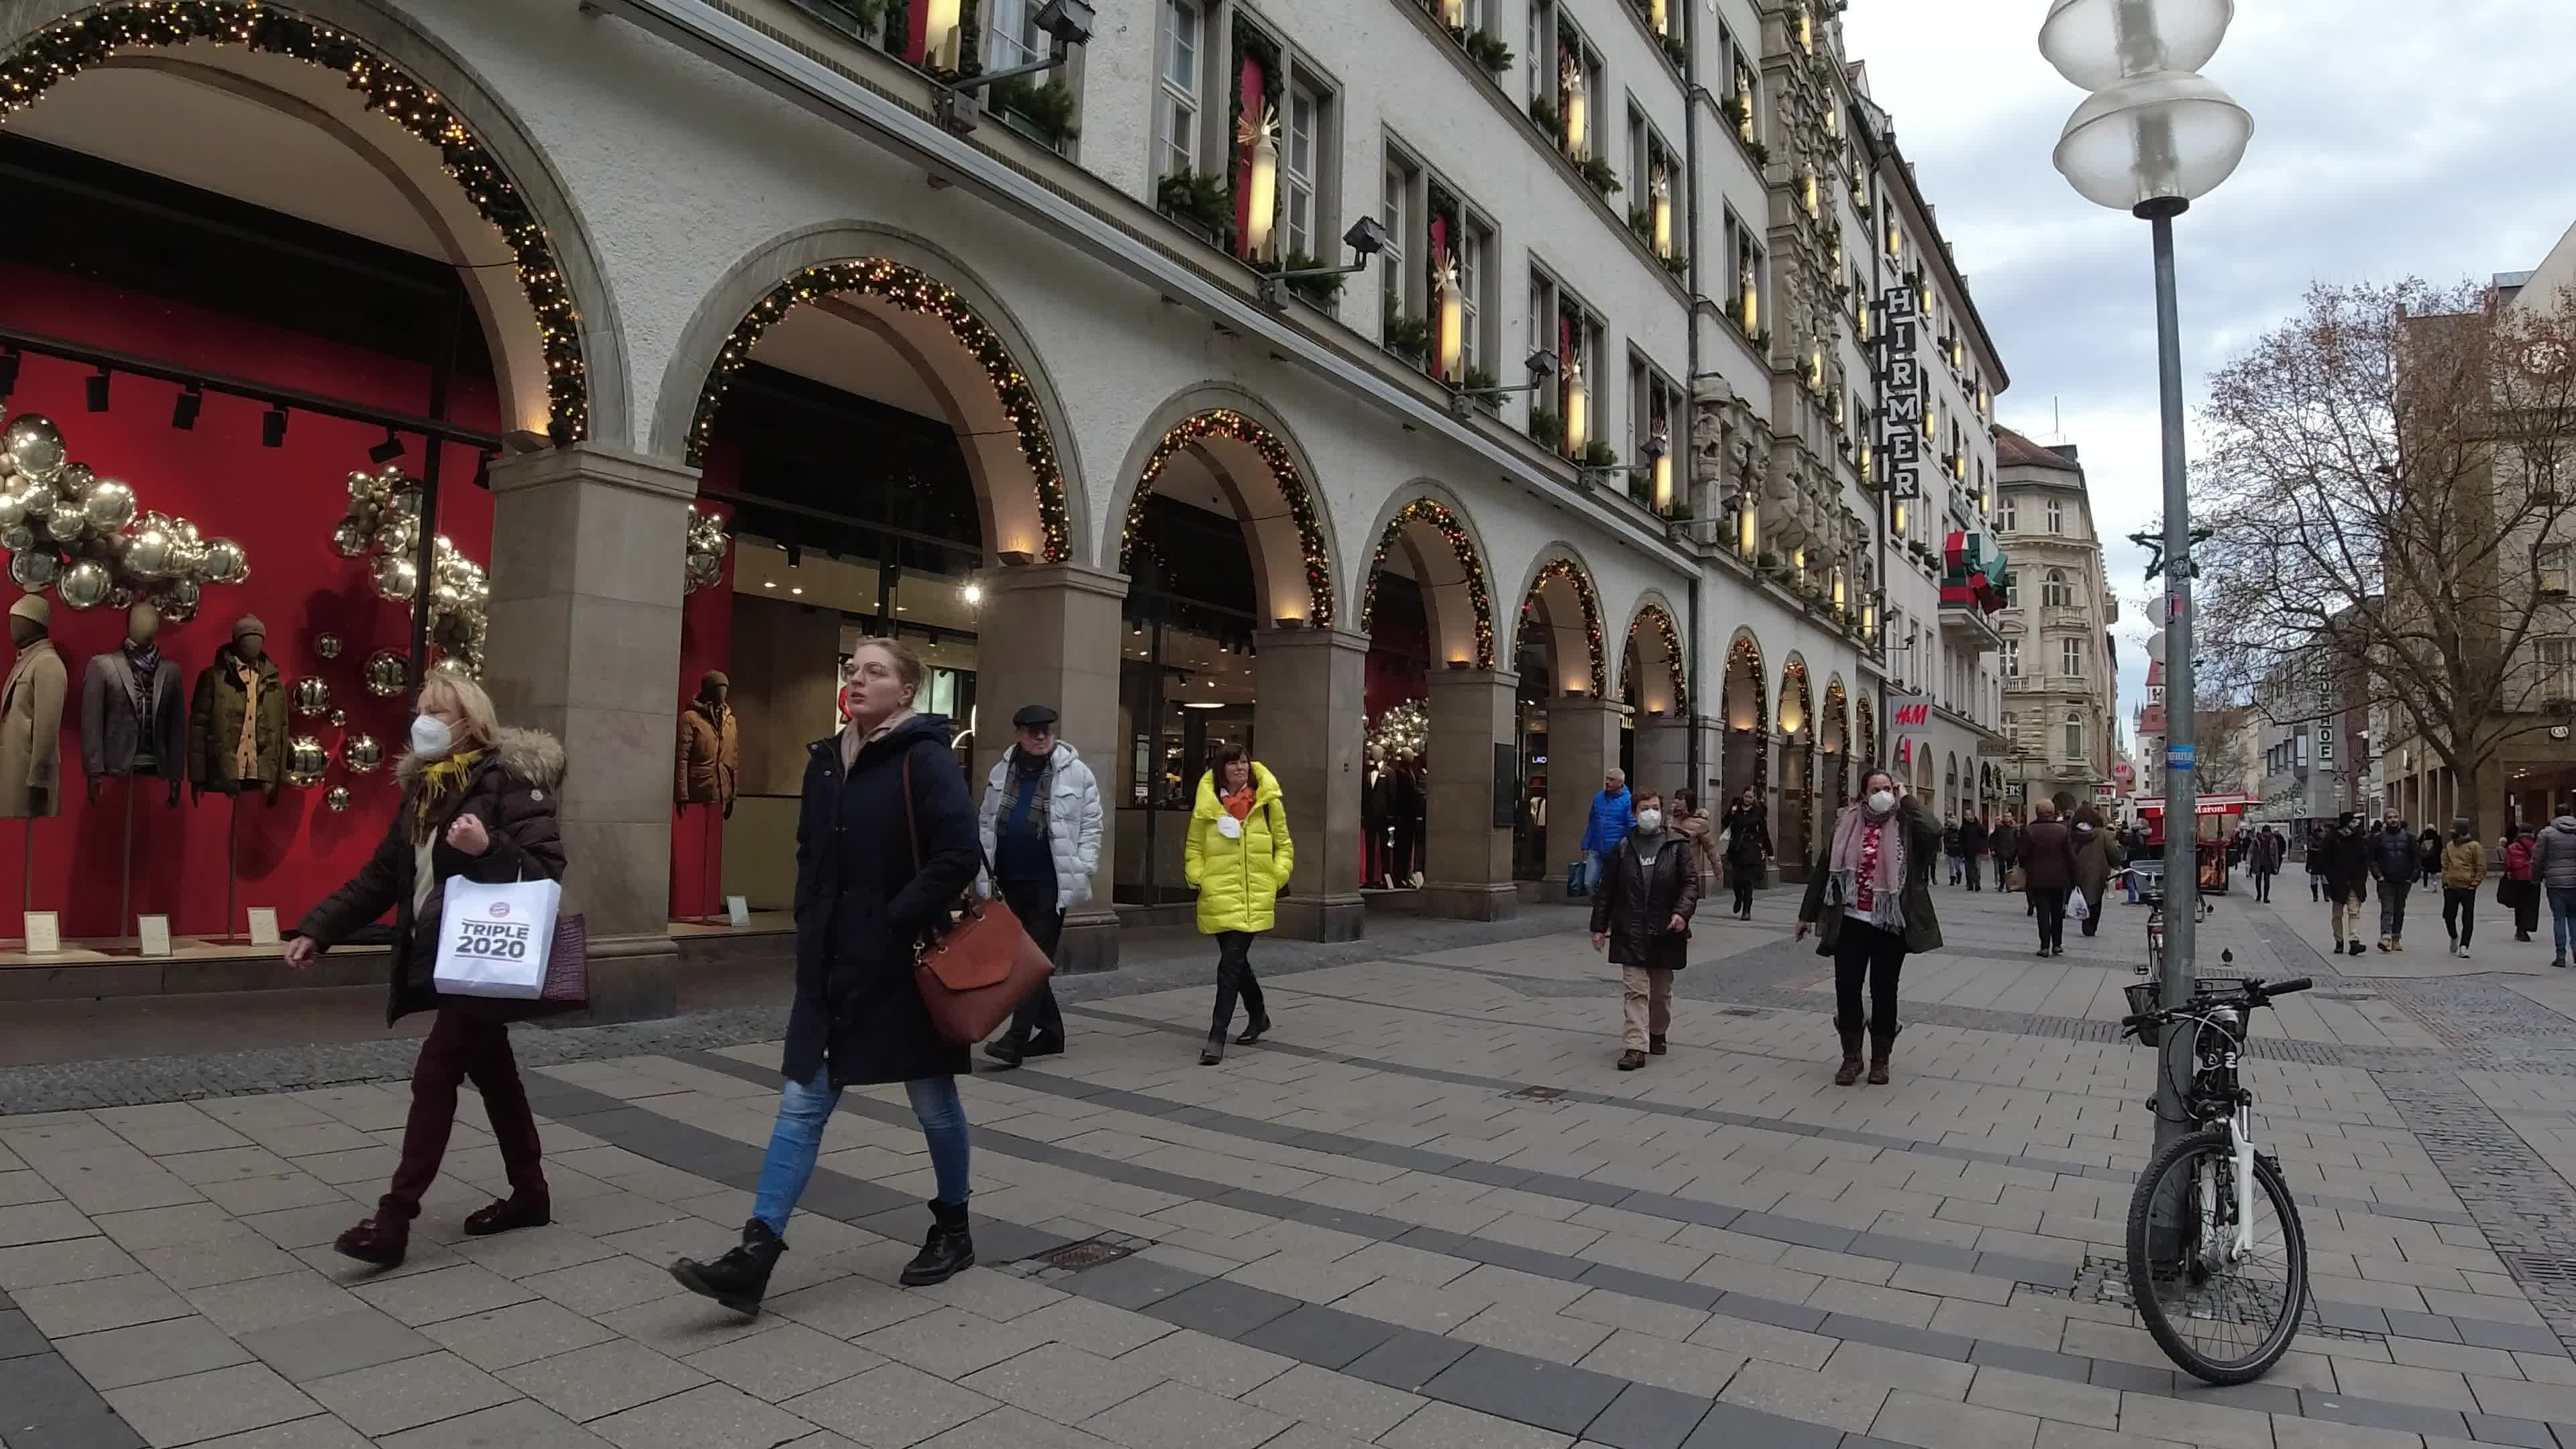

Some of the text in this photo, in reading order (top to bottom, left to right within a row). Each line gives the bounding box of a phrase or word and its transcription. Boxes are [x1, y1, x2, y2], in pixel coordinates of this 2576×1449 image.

[1888, 290, 1916, 496] HIRMER
[2319, 646, 2332, 757] UFHOF
[1895, 704, 1929, 725] H&M
[462, 922, 530, 940] TRIPLE
[455, 935, 526, 959] 2020
